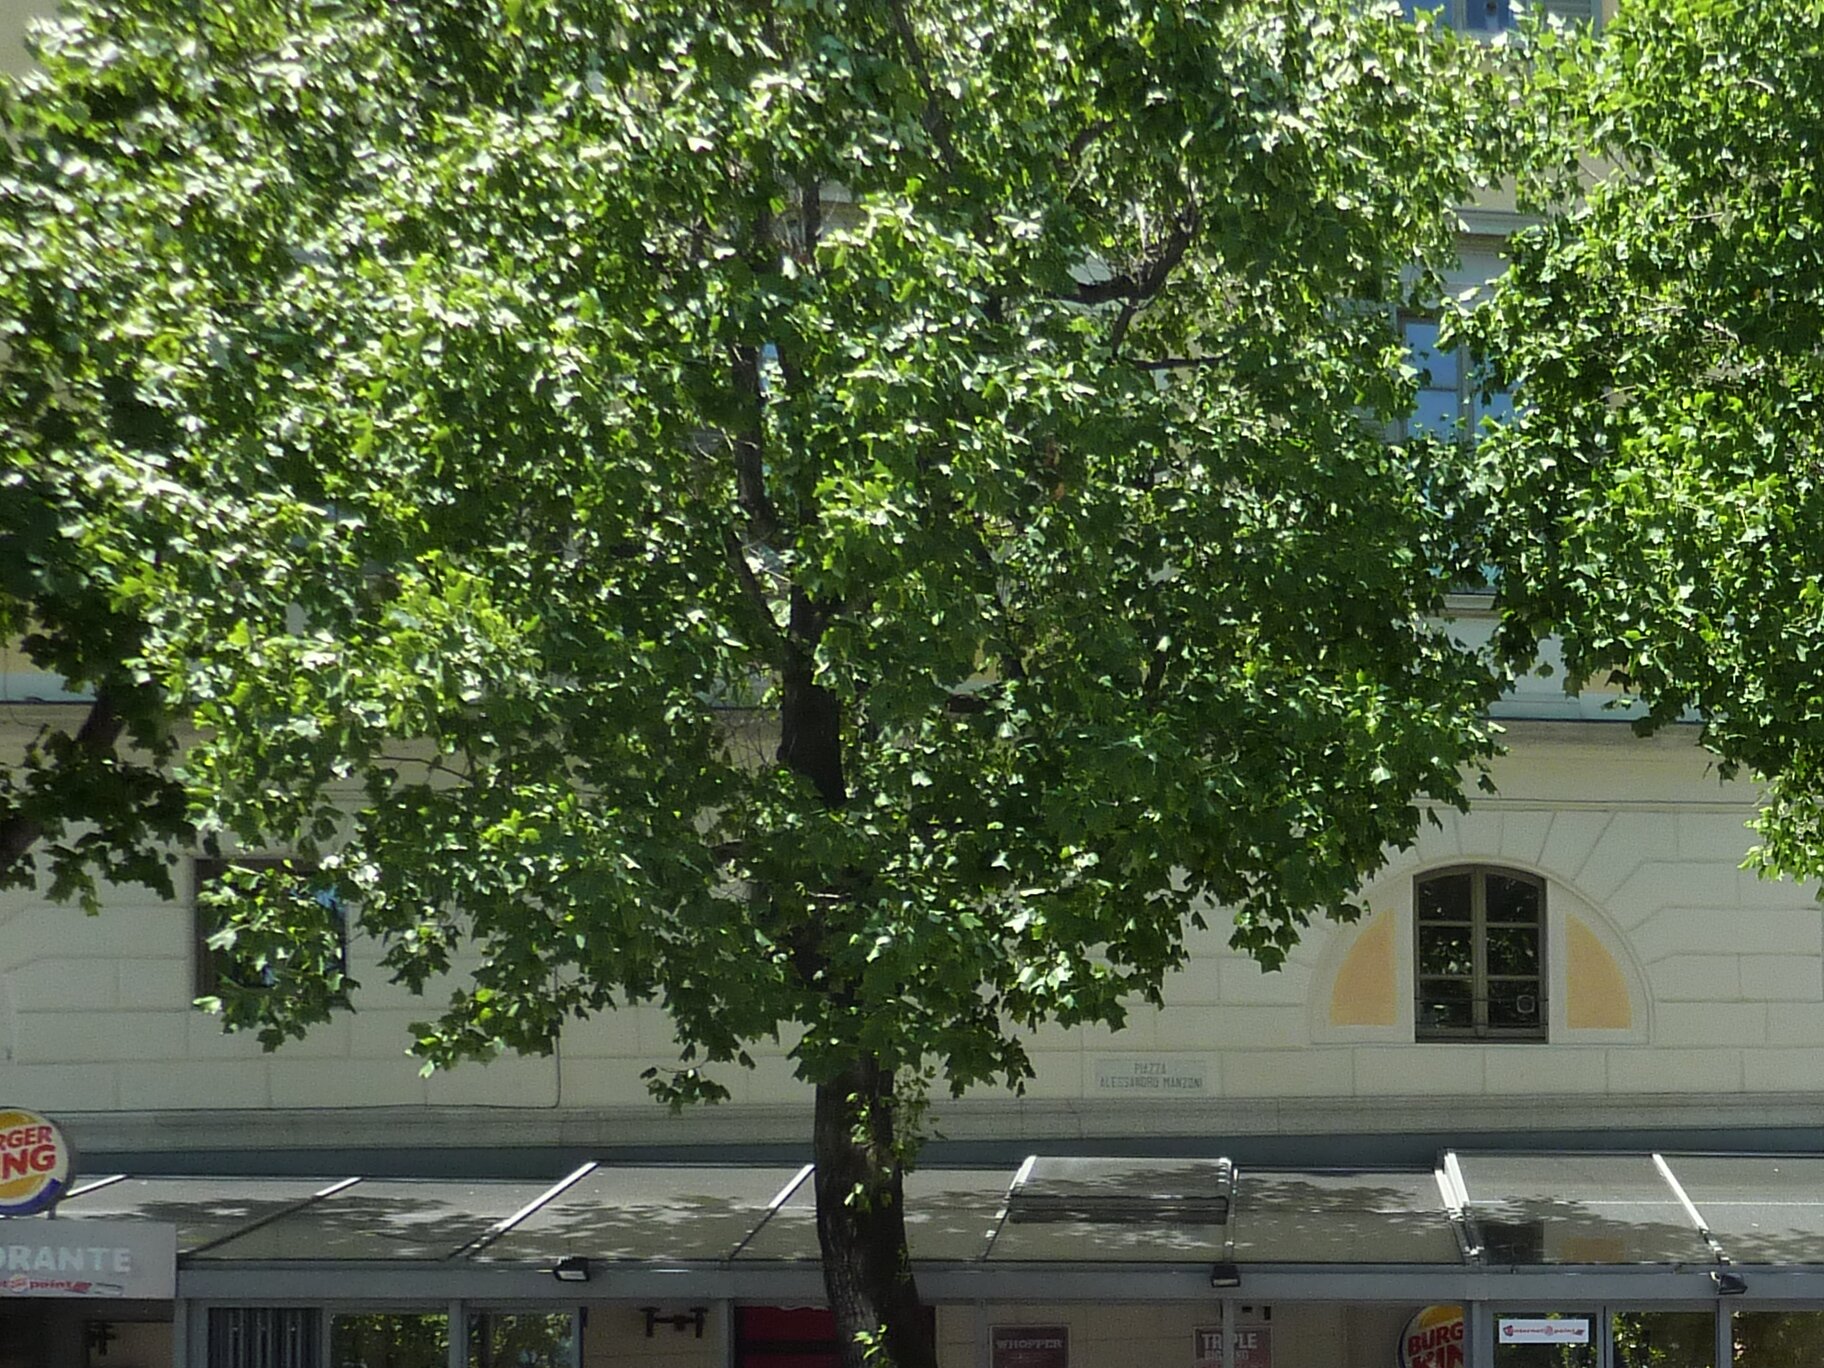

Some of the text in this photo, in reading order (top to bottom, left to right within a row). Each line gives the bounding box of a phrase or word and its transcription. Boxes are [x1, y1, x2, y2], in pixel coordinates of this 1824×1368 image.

[1134, 1063, 1166, 1074] PIAZZA
[1101, 1076, 1203, 1088] ALESSANDRO MANZONI
[0, 1126, 53, 1149] RGER
[0, 1144, 57, 1180] NG
[0, 1246, 131, 1273] RANTE
[996, 1339, 1063, 1349] WHOPPER
[1202, 1333, 1257, 1349] TRLE
[1408, 1321, 1464, 1357] BURG
